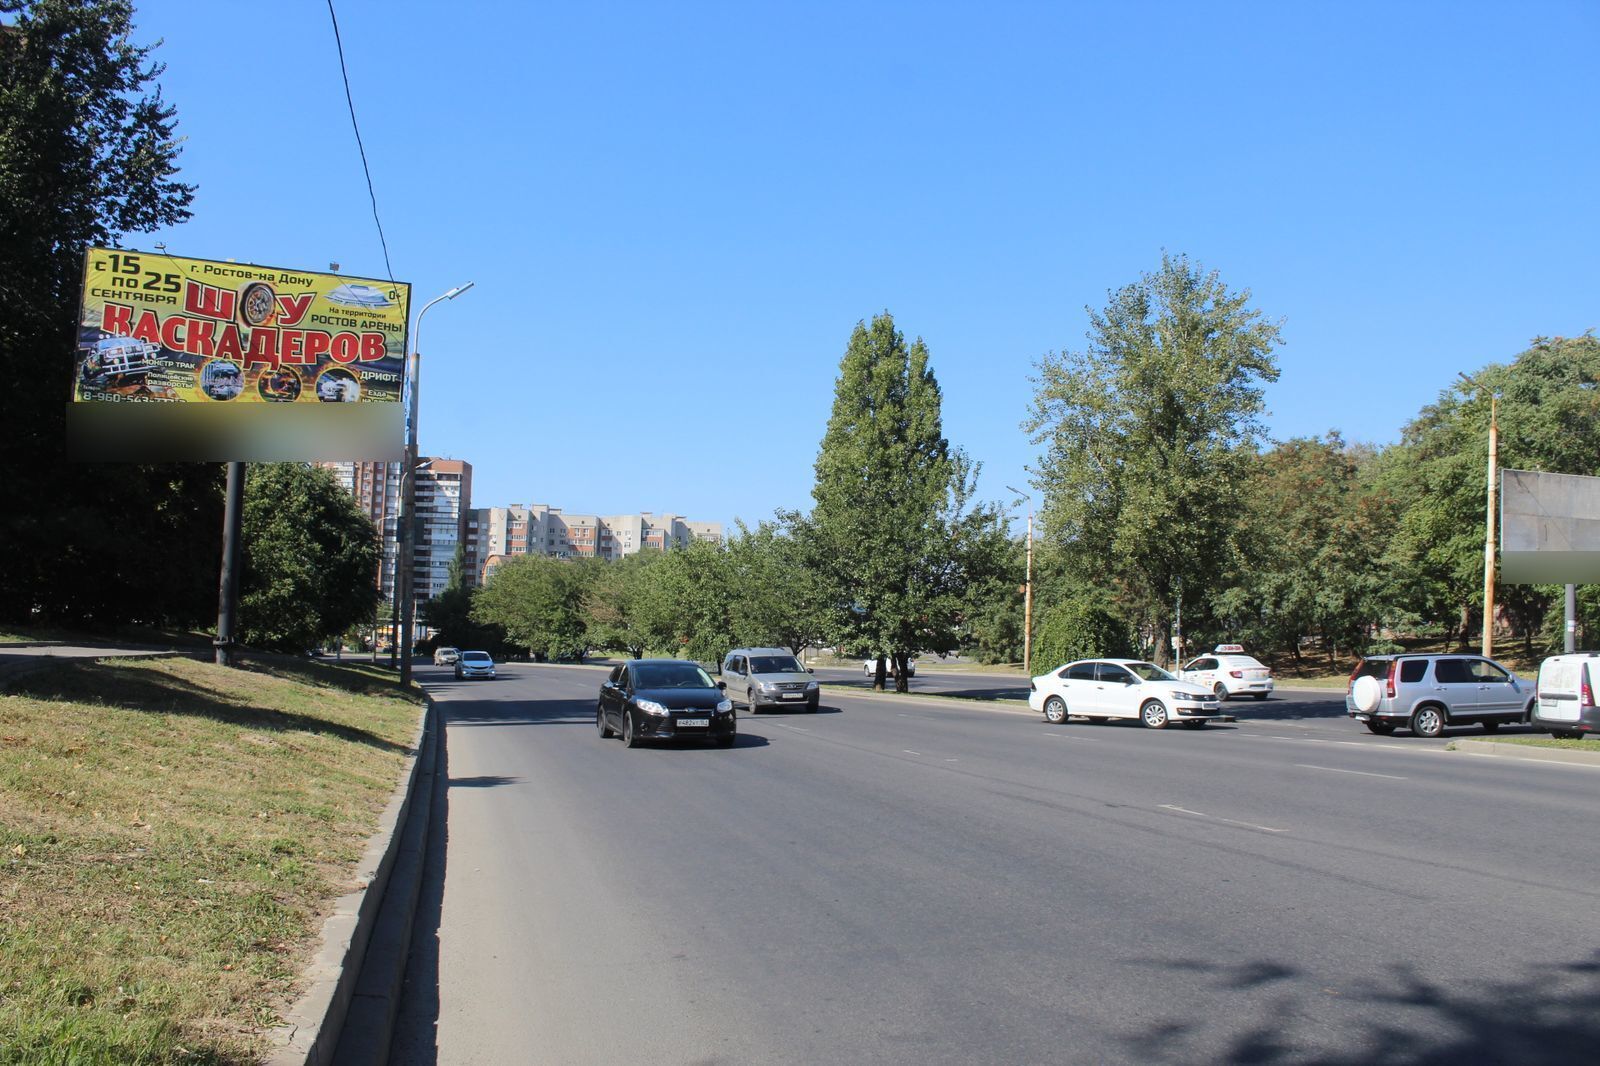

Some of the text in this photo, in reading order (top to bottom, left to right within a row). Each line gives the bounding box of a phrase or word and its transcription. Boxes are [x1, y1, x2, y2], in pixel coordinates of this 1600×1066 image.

[108, 254, 141, 275] 15
[143, 271, 182, 293] 25
[191, 264, 313, 288] г. Ростов-на Дону
[91, 288, 177, 305] СЕНТЯБРЯ
[183, 277, 317, 327] ШОУ
[311, 314, 402, 332] РОСТОВ АРЕНЫ
[329, 306, 387, 319] На территории
[101, 301, 387, 372] КАСКАДЕРОВ
[141, 358, 196, 369] МОНСТР ТРАК
